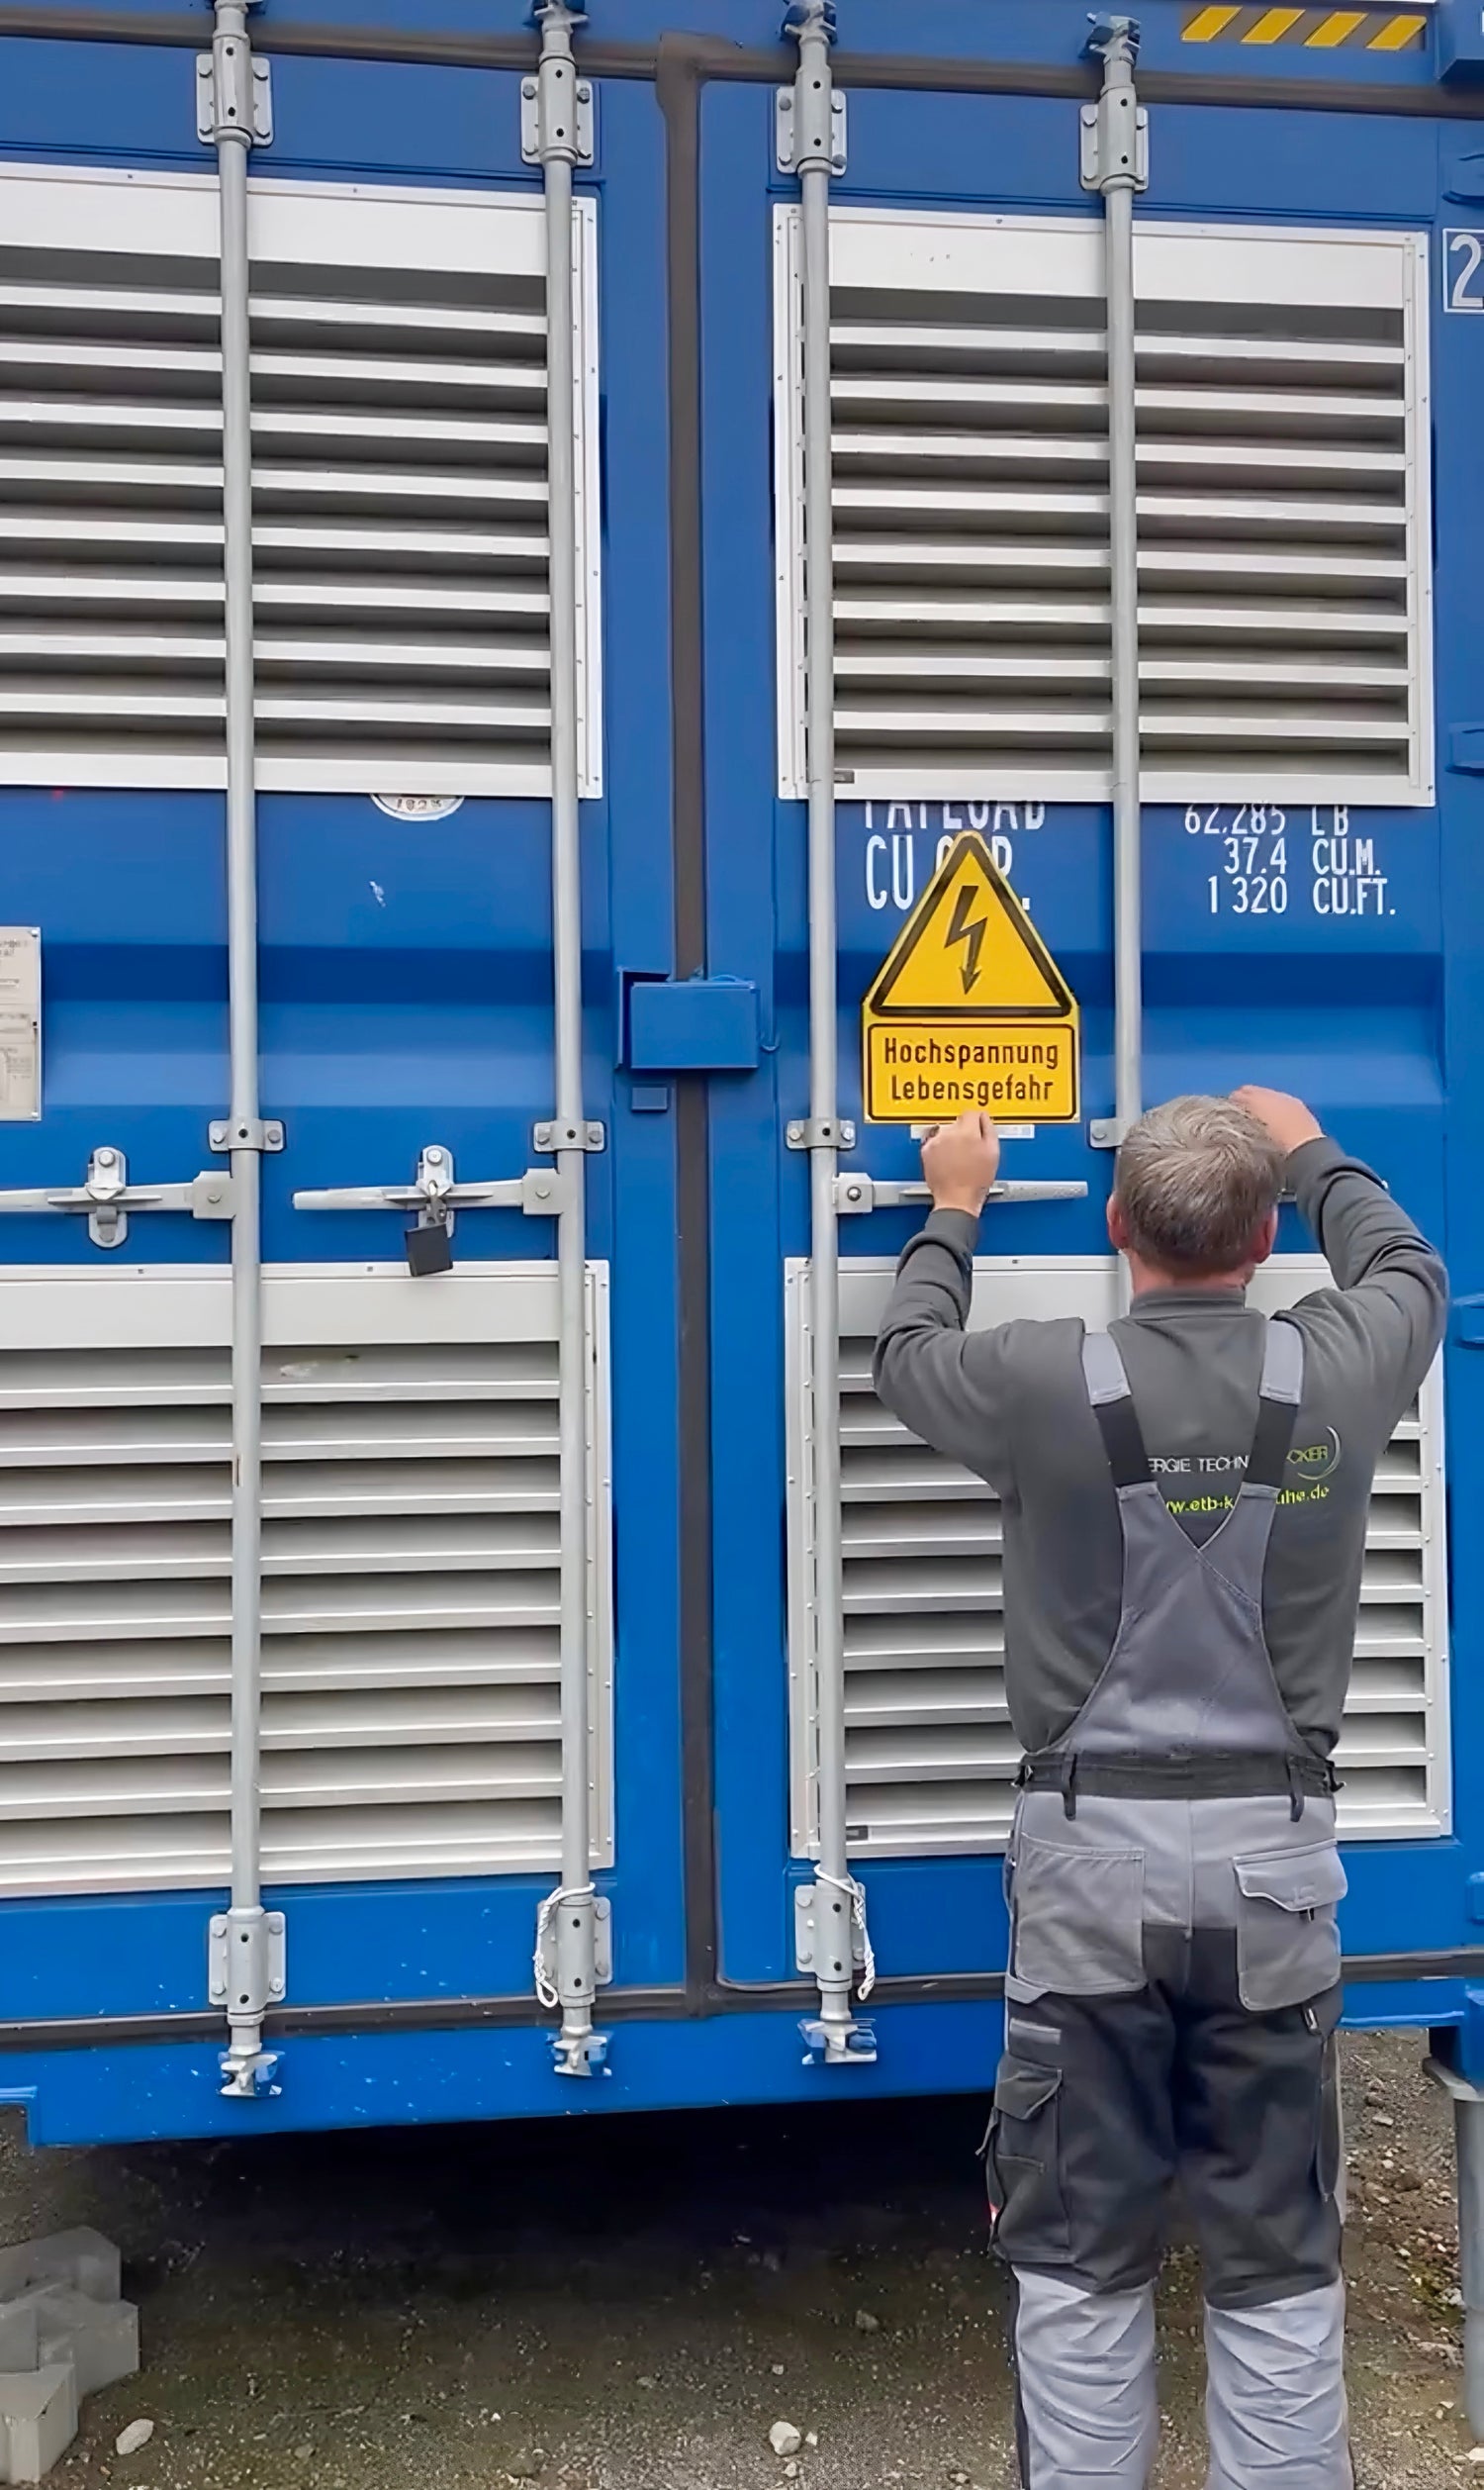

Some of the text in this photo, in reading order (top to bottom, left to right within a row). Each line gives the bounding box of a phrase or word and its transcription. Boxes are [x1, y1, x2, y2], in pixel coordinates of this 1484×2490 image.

[1223, 836, 1381, 875] 37.4 CU.M.
[1312, 877, 1396, 915] CU.FT.
[884, 1037, 1059, 1070] Hochspannung
[891, 1073, 1054, 1106] Lebensgefahr
